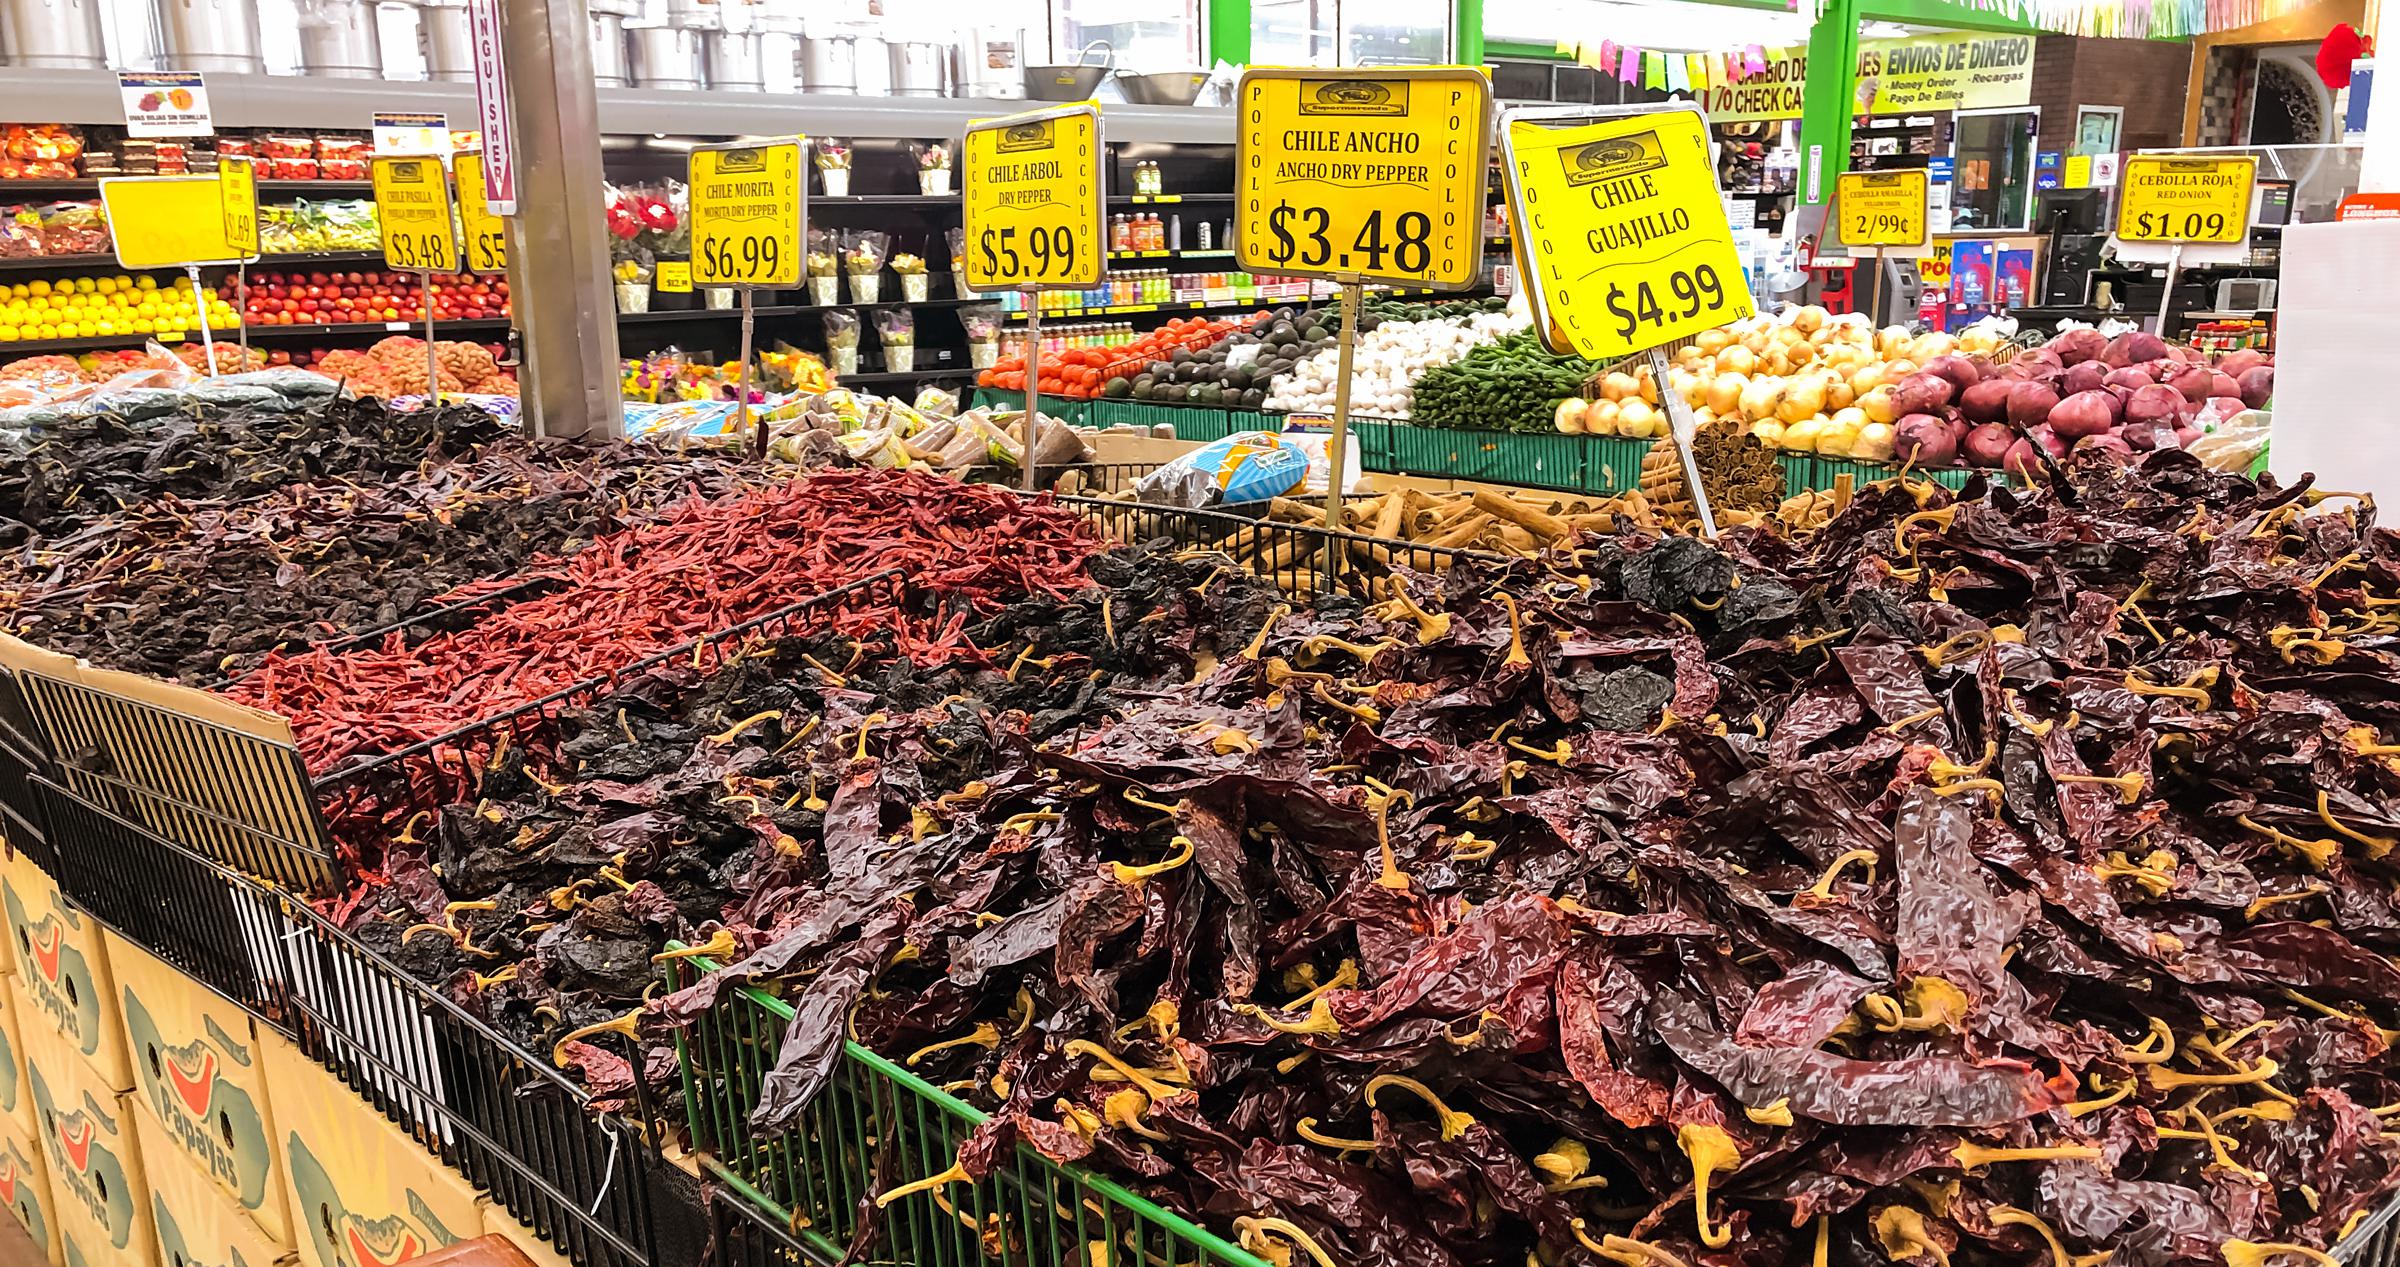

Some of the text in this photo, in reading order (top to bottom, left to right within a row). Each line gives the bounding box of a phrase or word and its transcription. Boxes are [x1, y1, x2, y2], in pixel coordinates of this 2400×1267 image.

[1887, 37, 2029, 75] ENVIOS DE DINERO
[1890, 78, 1957, 91] Money Order
[1972, 72, 2024, 84] Recargas
[1735, 87, 1781, 113] CHECK
[1889, 93, 1915, 105] Pago
[1918, 92, 1932, 101] De
[1283, 130, 1420, 154] CHILE ANCHO
[988, 160, 1063, 183] CHILE ARBOL
[1276, 162, 1428, 182] ANCHO DRY PEPPER
[2139, 175, 2233, 188] CEBOLLA ROJA
[387, 191, 432, 203] CHILE PASILLA
[706, 181, 774, 199] CHILE MORITA
[999, 189, 1052, 205] DRY PEPPER
[1590, 174, 1658, 210] CHILE
[2157, 190, 2212, 199] RED ONION
[704, 204, 778, 218] MORITA DRY PEPPER
[228, 212, 250, 242] $1.69
[1268, 199, 1431, 273] $3.48
[1586, 207, 1690, 254] GUAJILLO
[1856, 214, 1909, 239] 2/99¢
[2136, 211, 2224, 238] $1.09
[391, 230, 444, 268] $3.48
[704, 232, 778, 282] $6.99
[981, 224, 1074, 283] $5.99
[1606, 264, 1724, 345] $4.99
[1734, 305, 1748, 320] LB
[30, 958, 80, 1039] Papayas
[160, 1084, 238, 1188] Papayas
[55, 1142, 110, 1231] Papayas
